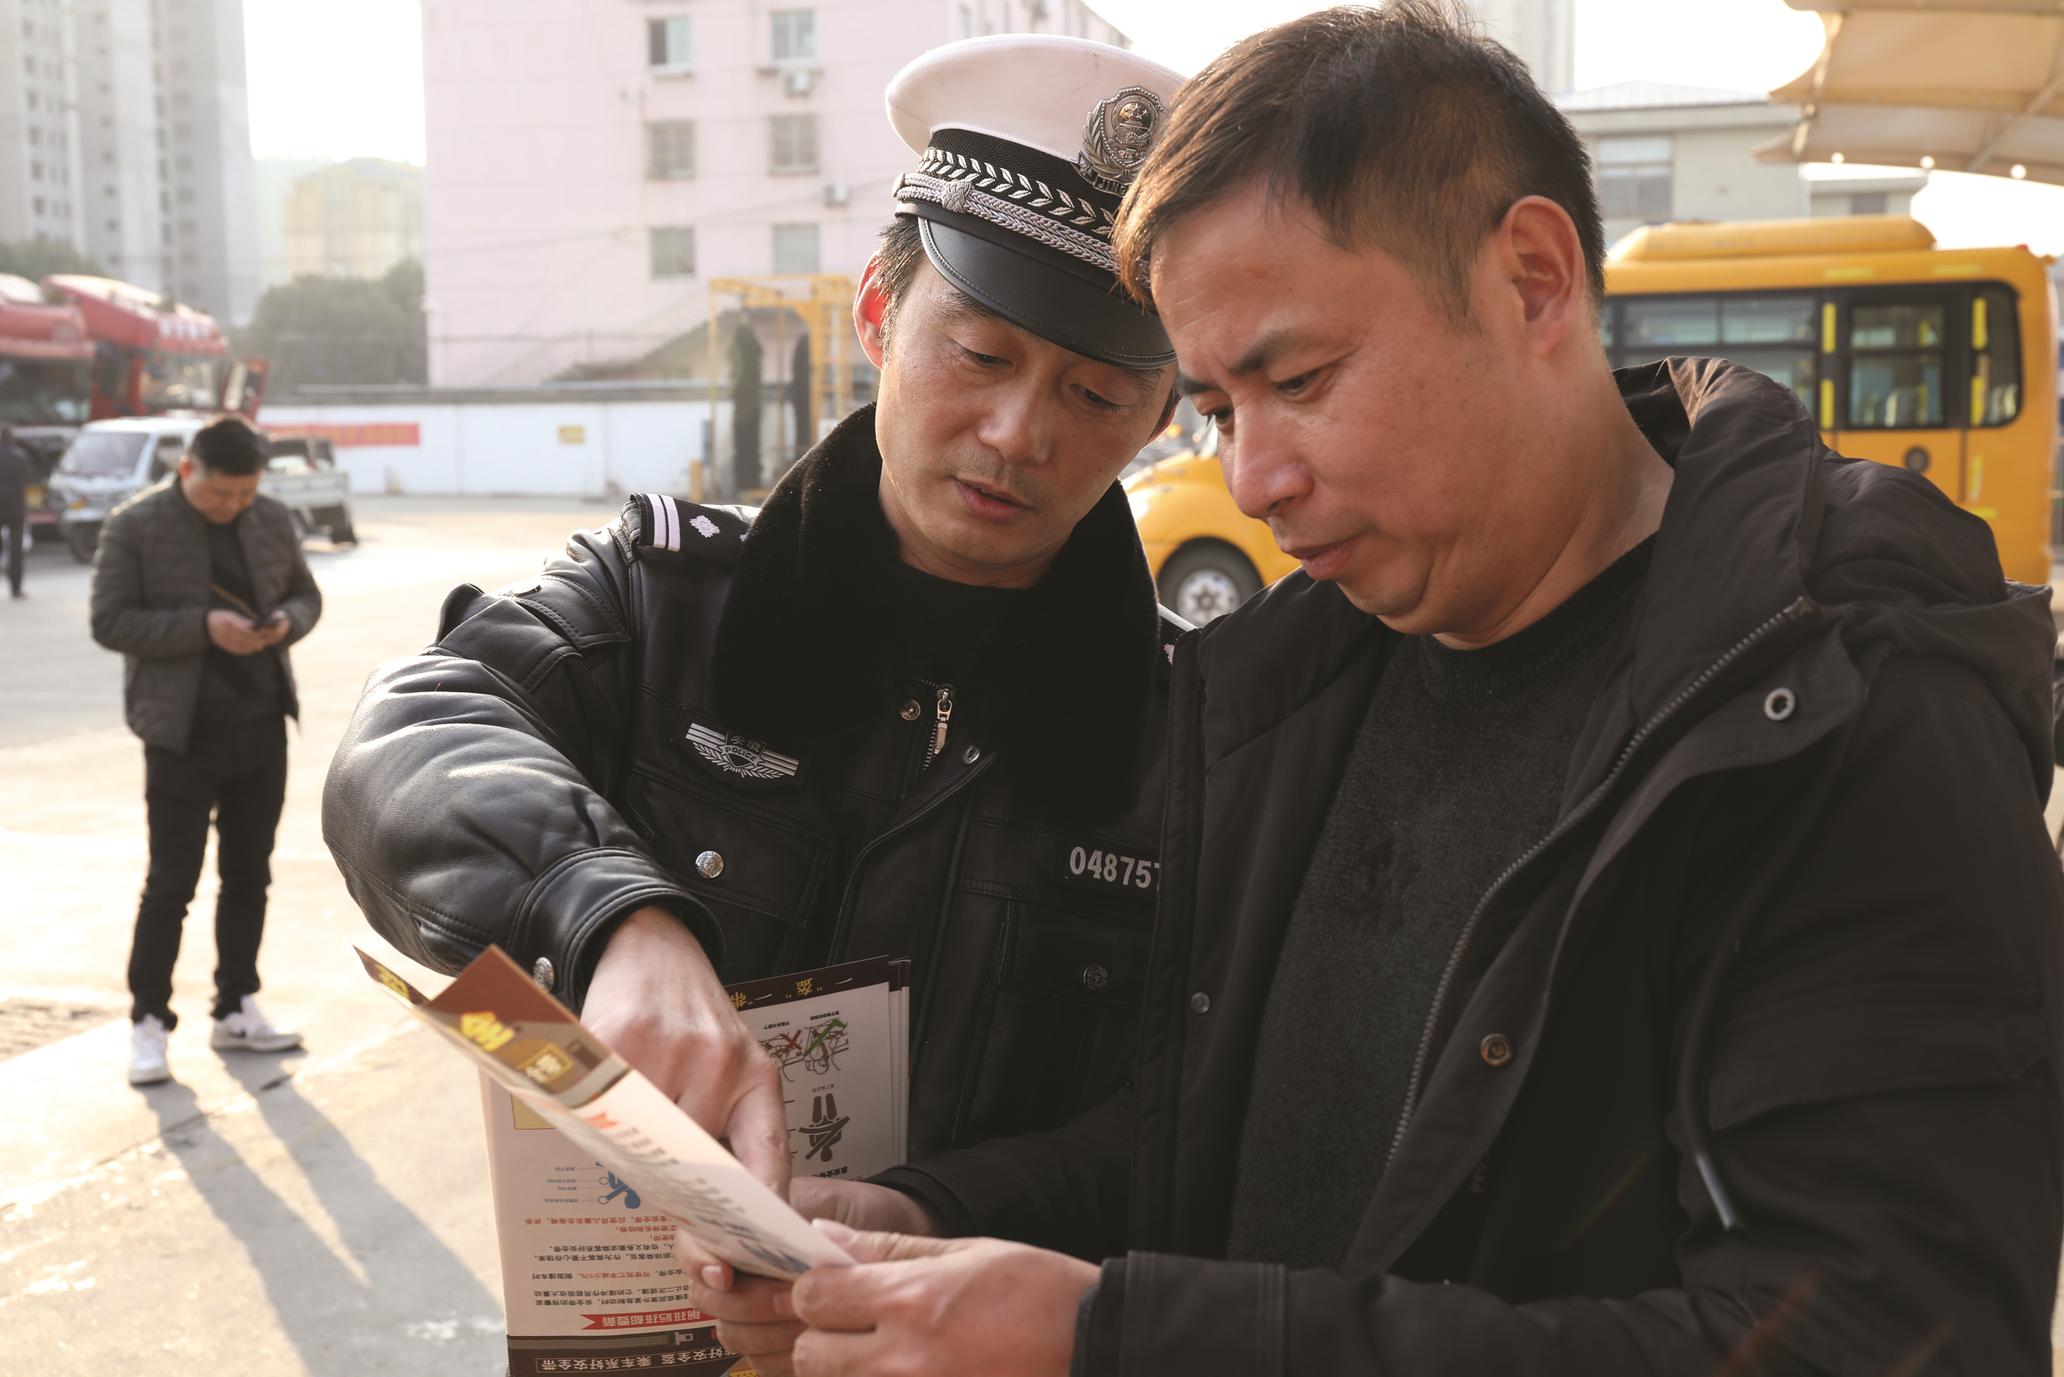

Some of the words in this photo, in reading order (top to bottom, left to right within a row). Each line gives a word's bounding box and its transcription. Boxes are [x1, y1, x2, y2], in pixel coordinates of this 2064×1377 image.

[725, 745, 758, 761] POLICE
[541, 1355, 652, 1371] 乘车系好安全带
